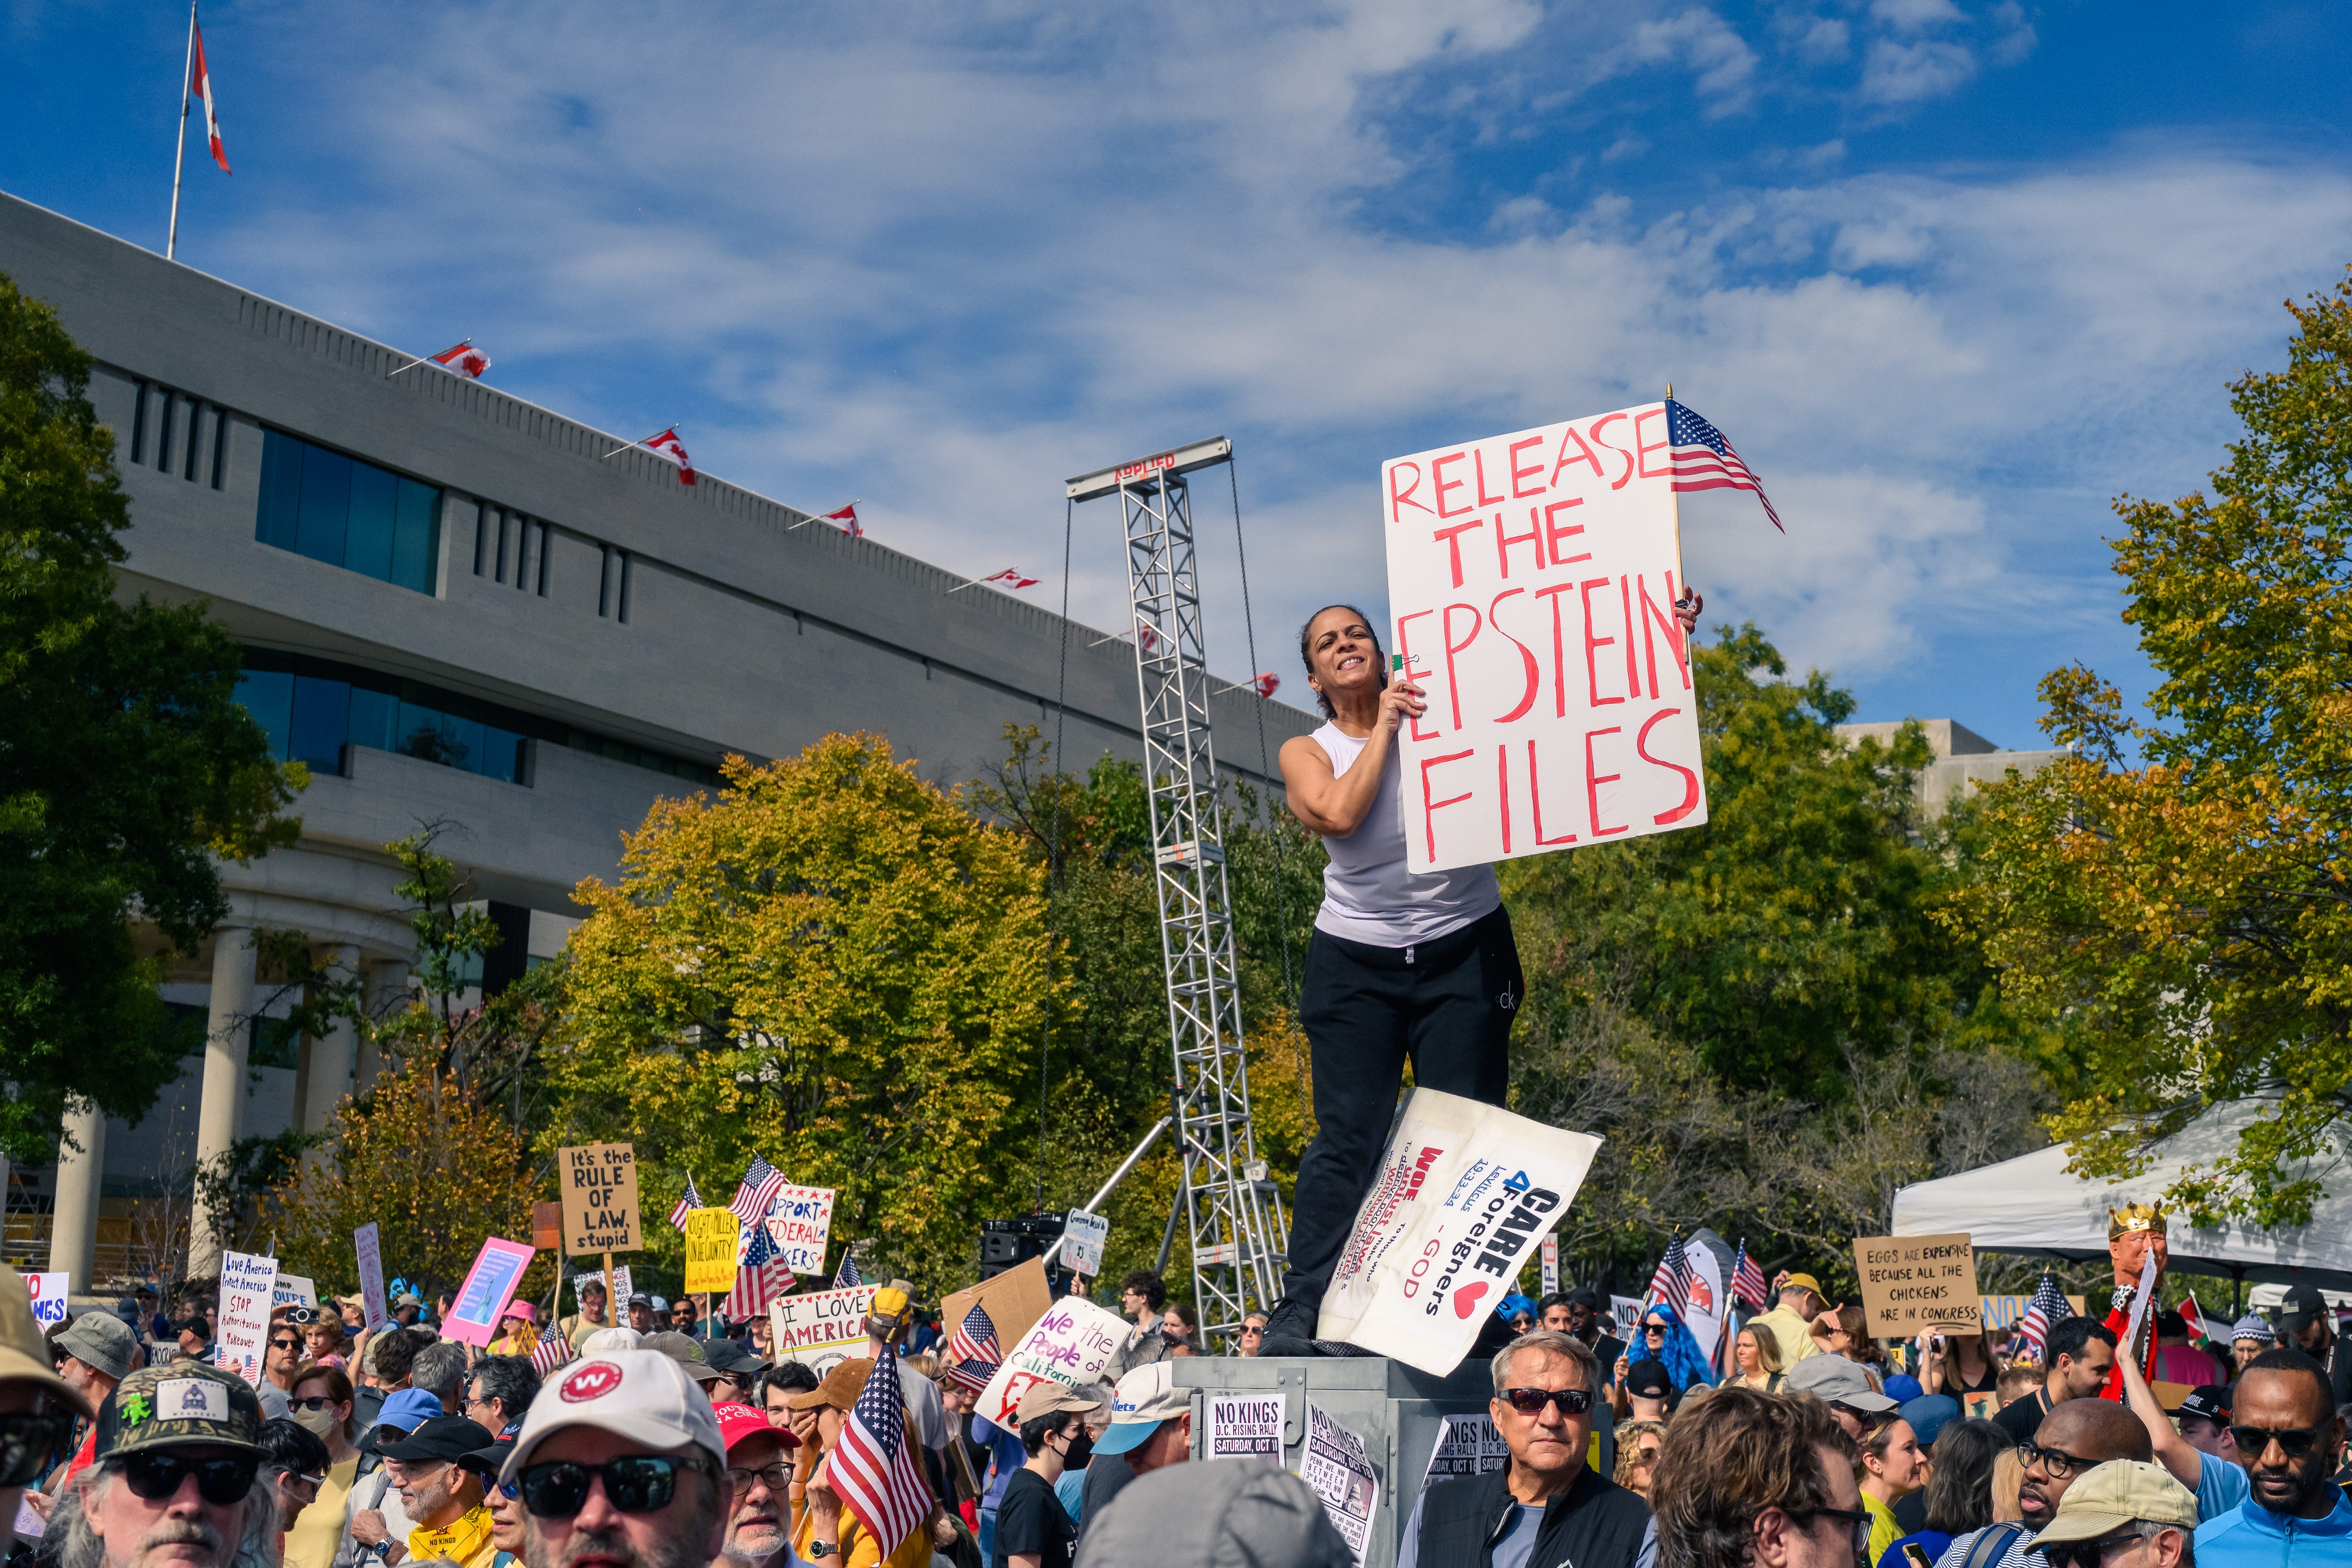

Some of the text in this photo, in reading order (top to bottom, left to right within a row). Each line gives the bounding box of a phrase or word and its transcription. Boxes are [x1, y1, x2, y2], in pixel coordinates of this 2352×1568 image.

[1390, 408, 1670, 523] RELEASE
[1432, 497, 1592, 589] THE
[1398, 570, 1691, 741] EPSTEIN
[1421, 708, 1699, 863] FILES
[1404, 1141, 1412, 1152] To
[571, 1149, 631, 1167] It's the
[574, 1167, 624, 1188] RULE
[1386, 1155, 1407, 1200] deprive
[1403, 1147, 1444, 1201] WOE
[589, 1188, 613, 1207] OF
[1363, 1167, 1397, 1225] Withhold
[1372, 1187, 1381, 1199] you
[1379, 1167, 1413, 1226] unjust
[1461, 1165, 1507, 1212] Leviticus
[765, 1198, 822, 1221] UPPORT
[1366, 1200, 1372, 1208] do
[584, 1209, 630, 1230] LAW,
[713, 1208, 736, 1235] MILLER
[1369, 1203, 1386, 1229] poor
[577, 1230, 629, 1250] stupid
[768, 1219, 824, 1244] EDERAL
[1360, 1231, 1368, 1244] of
[1473, 1188, 1560, 1278] CARE
[705, 1235, 734, 1262] COUNTRY
[778, 1247, 818, 1270] KERS
[1354, 1230, 1382, 1273] laws
[1367, 1237, 1383, 1261] make
[1367, 1223, 1406, 1282] To those who
[1868, 1244, 1969, 1264] EGGS ARE EXPENSIVE
[226, 1253, 272, 1275] Love America
[1404, 1239, 1440, 1298] GOD
[1869, 1265, 1962, 1282] BECAUSE ALL THE
[222, 1273, 267, 1293] Protect America
[275, 1280, 294, 1291] UMP.
[1890, 1285, 1948, 1301] CHICKENS
[34, 1298, 64, 1321] NGS
[230, 1295, 252, 1313] STOP
[274, 1290, 307, 1307] OU'RE
[782, 1295, 868, 1323] I LOVE
[221, 1314, 261, 1331] Authoritarian
[1880, 1306, 1977, 1321] ARE IN CONGRESS
[1983, 1296, 2017, 1330] NO
[227, 1333, 255, 1348] Takeover
[783, 1317, 868, 1348] AMERICA
[1040, 1310, 1074, 1335] We
[1080, 1321, 1113, 1354] the
[1025, 1331, 1105, 1373] People of
[574, 1372, 607, 1391] W
[1215, 1402, 1278, 1424] NO KINGS
[1216, 1424, 1277, 1436] D.C. RISING RALLY
[1311, 1404, 1364, 1455] NO KINGS
[1443, 1422, 1477, 1444] INGS
[1482, 1420, 1500, 1442] NO
[1216, 1439, 1278, 1453] SATURDAY, OCT 18
[1313, 1423, 1366, 1465] D.C. RISING RALLY
[1436, 1444, 1476, 1456] SING RALLY
[1482, 1442, 1509, 1454] D.C. RIS
[1310, 1455, 1345, 1478] PENN. AVE. NW
[1311, 1438, 1372, 1478] SATURDAY, OCT 18
[1453, 1460, 1467, 1472] OCT
[1482, 1458, 1506, 1470] SATUR
[1308, 1463, 1344, 1486] BETWEEN
[1334, 1484, 1342, 1494] NW
[1345, 1518, 1355, 1527] SHOW
[439, 1537, 456, 1545] KINGS
[1346, 1536, 1359, 1546] PEOPLE.
[1350, 1529, 1361, 1539] POWER
